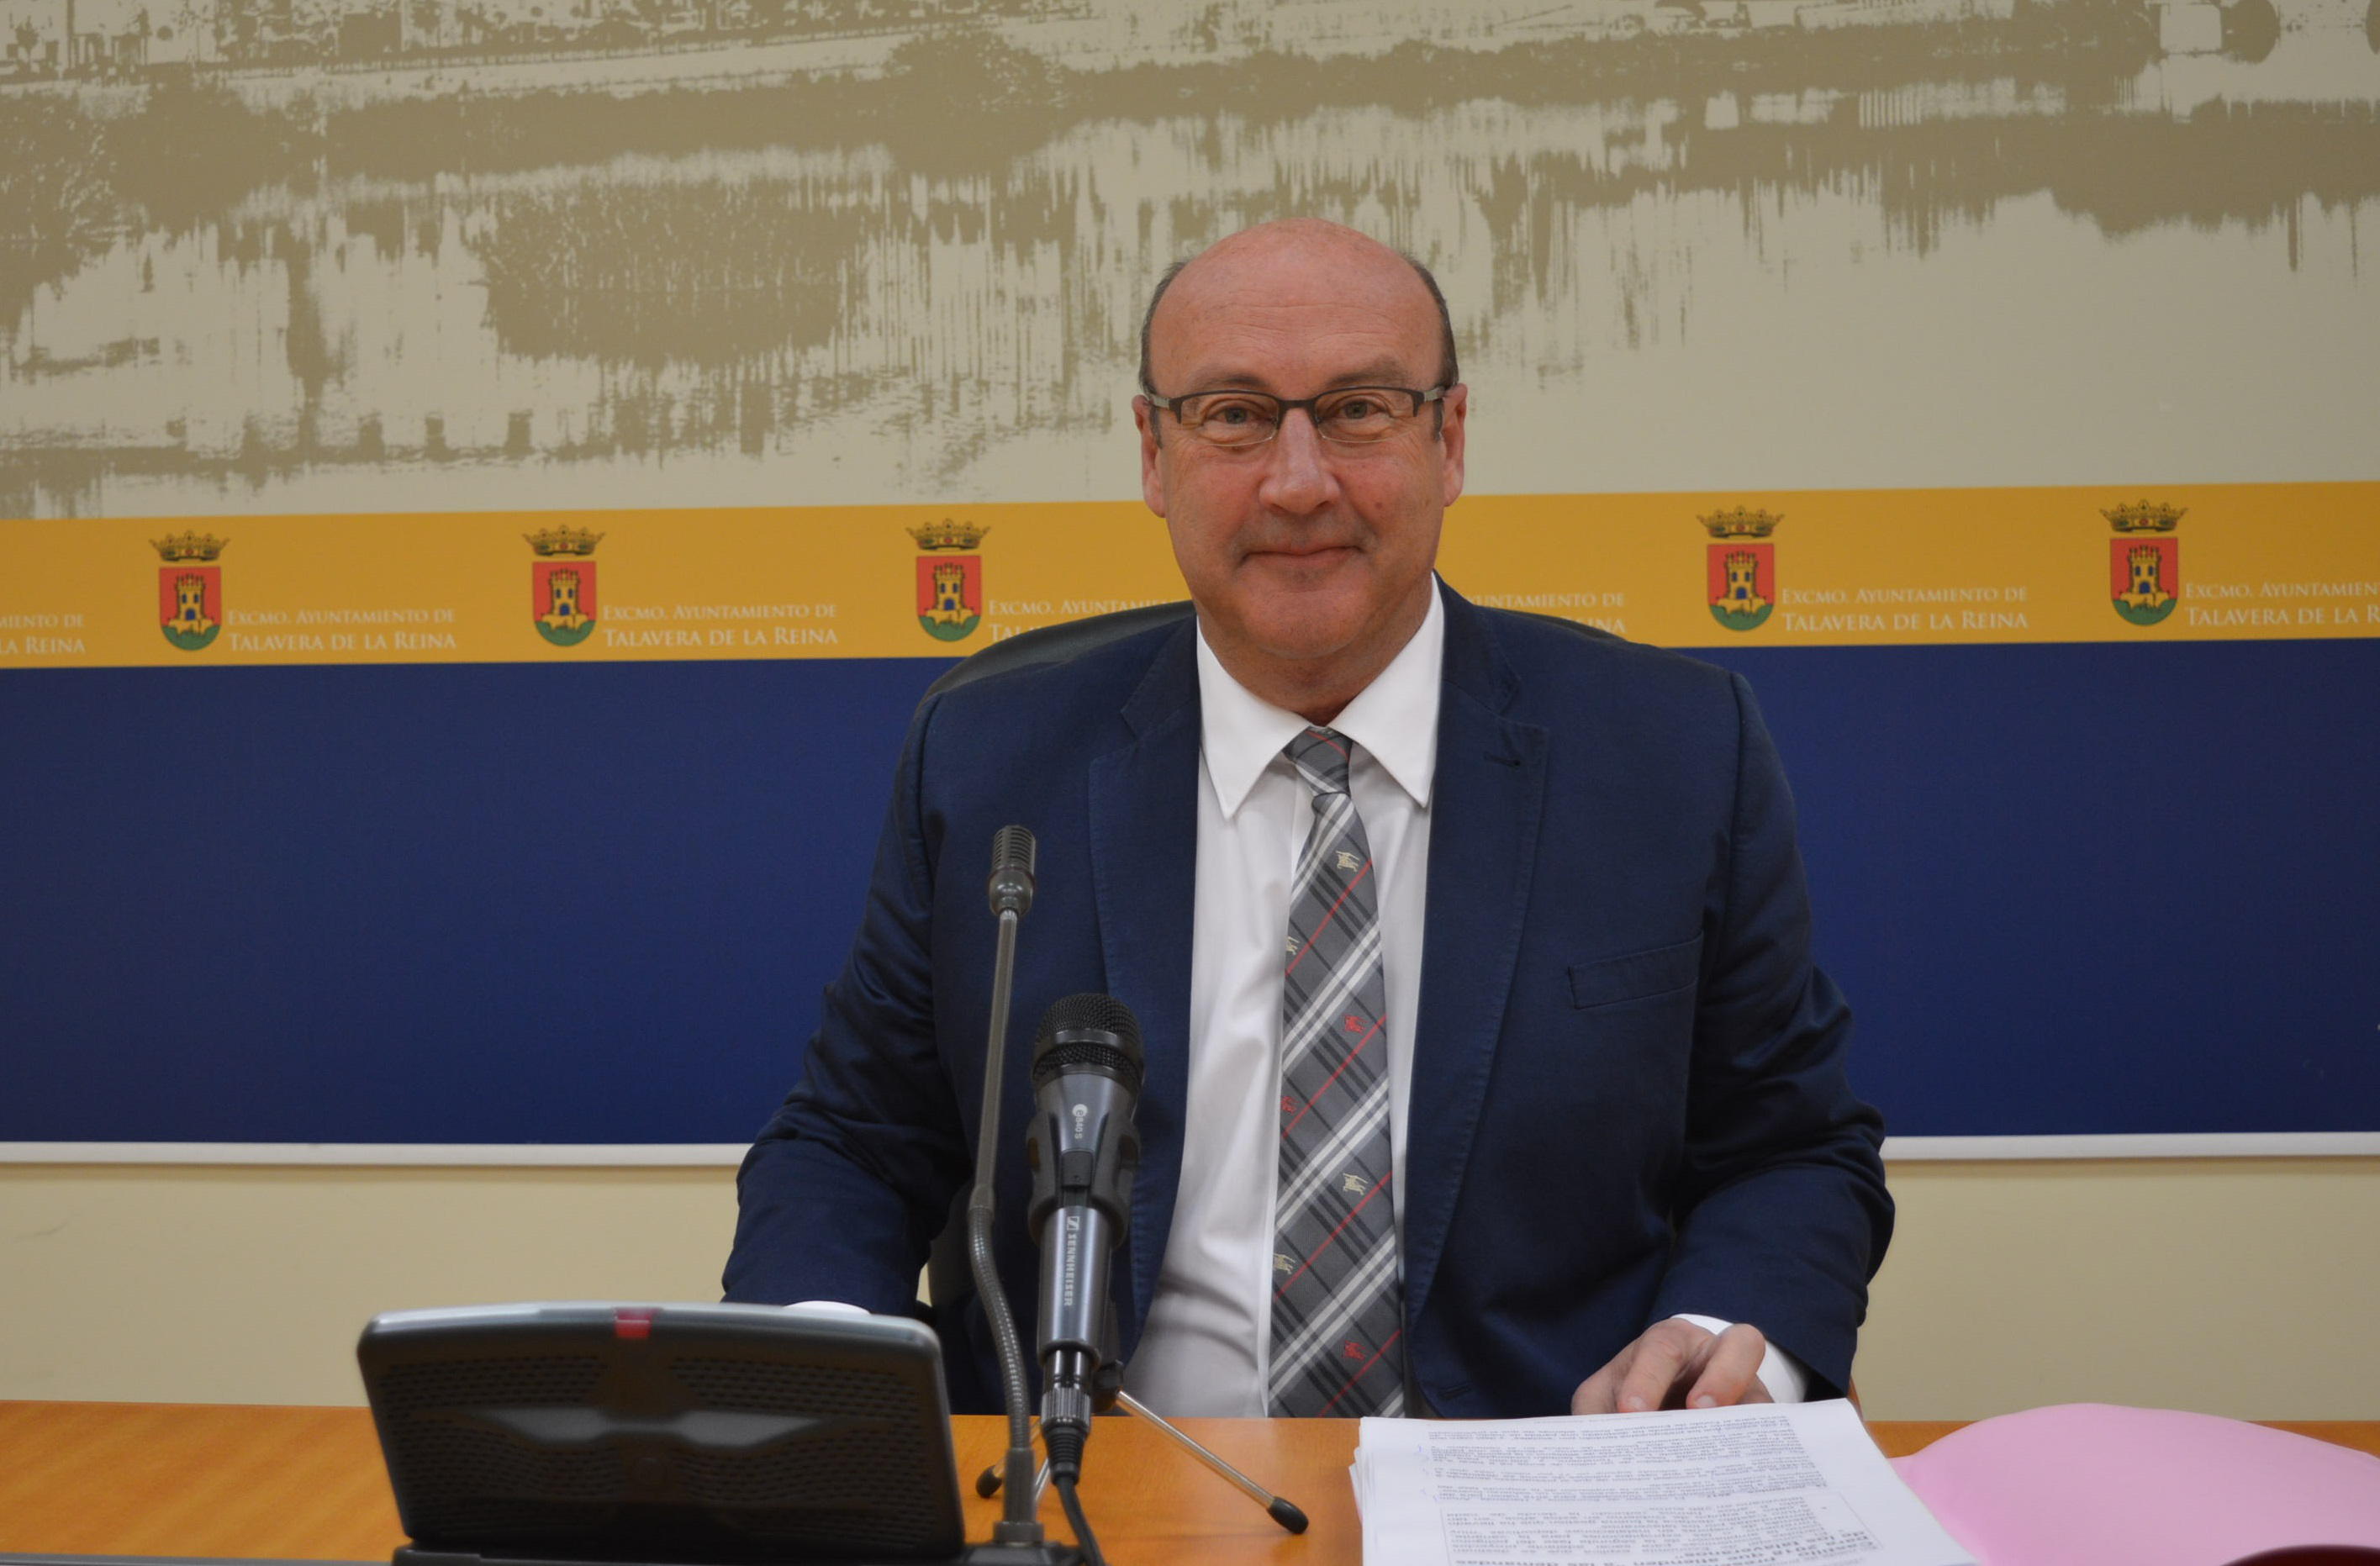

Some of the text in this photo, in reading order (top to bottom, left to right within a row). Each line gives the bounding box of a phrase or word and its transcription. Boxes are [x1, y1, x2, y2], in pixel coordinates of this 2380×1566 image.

[1602, 591, 1625, 607] DE
[1856, 587, 1998, 604] AYUNTAMIENTO
[2003, 586, 2028, 602] DE
[64, 614, 84, 628] DE
[295, 609, 429, 625] AYUNTAMIENTO
[433, 609, 456, 623] DE
[673, 604, 810, 620] AYUNTAMIENTO
[814, 604, 837, 619] DE
[1781, 611, 2029, 631] TALAVERA DE LA REINA
[2187, 607, 2291, 625] TALAVERA
[2298, 608, 2325, 625] DE
[2334, 608, 2359, 624] LA
[26, 635, 86, 654] REINA
[229, 631, 457, 651] TALAVERA DE LA REINA
[603, 627, 838, 647] TALAVERA DE LA REINA
[1063, 1233, 1078, 1306] SENNHEISER
